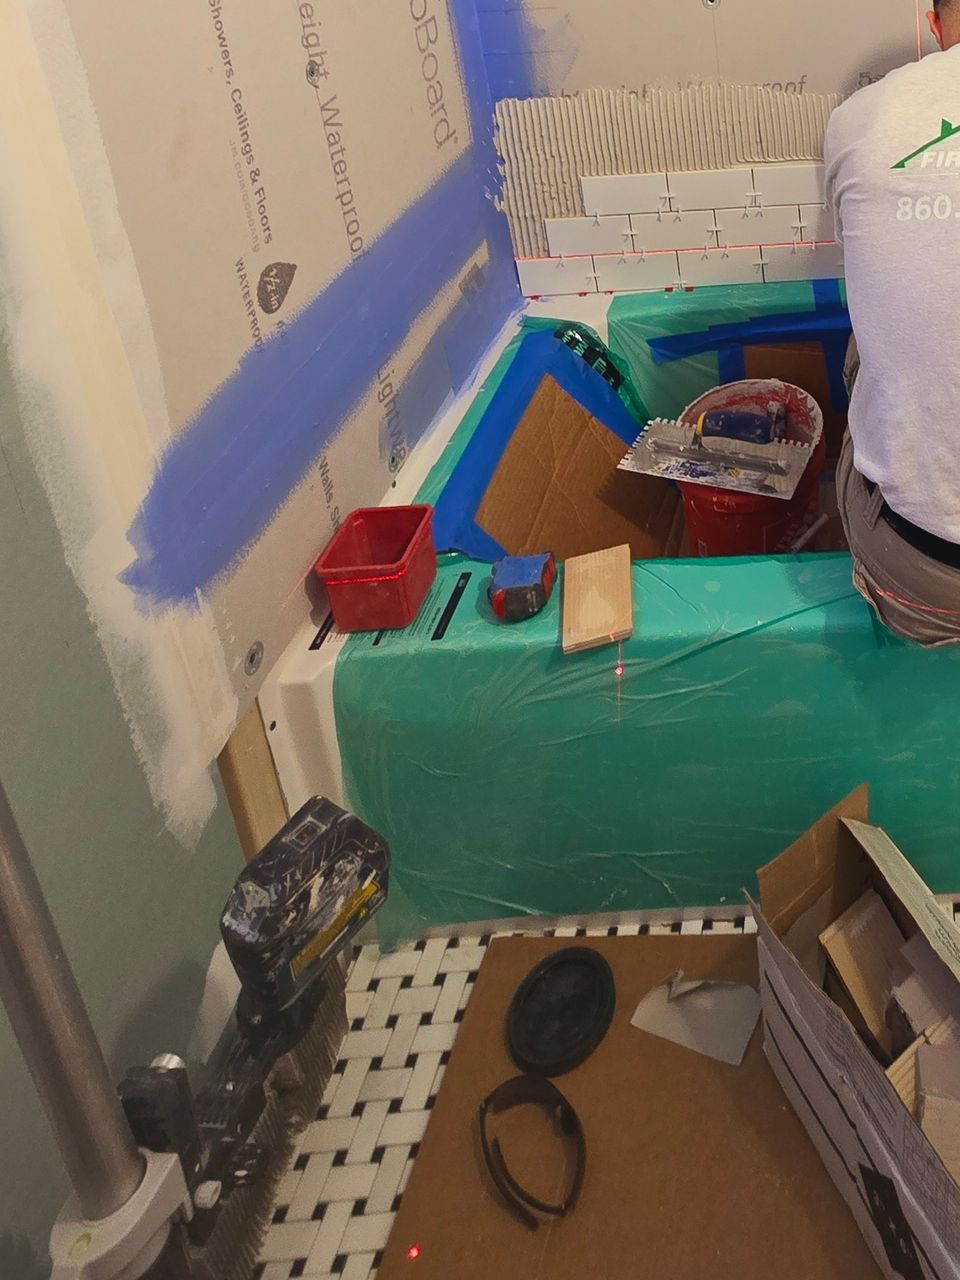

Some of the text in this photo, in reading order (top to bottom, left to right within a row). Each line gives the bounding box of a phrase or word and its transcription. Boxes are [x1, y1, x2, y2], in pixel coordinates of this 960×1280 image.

[231, 88, 256, 166] Ceilings
[248, 166, 262, 185] &
[319, 94, 364, 258] Waterproo
[253, 186, 274, 246] Floors
[235, 257, 265, 349] WATERPROO
